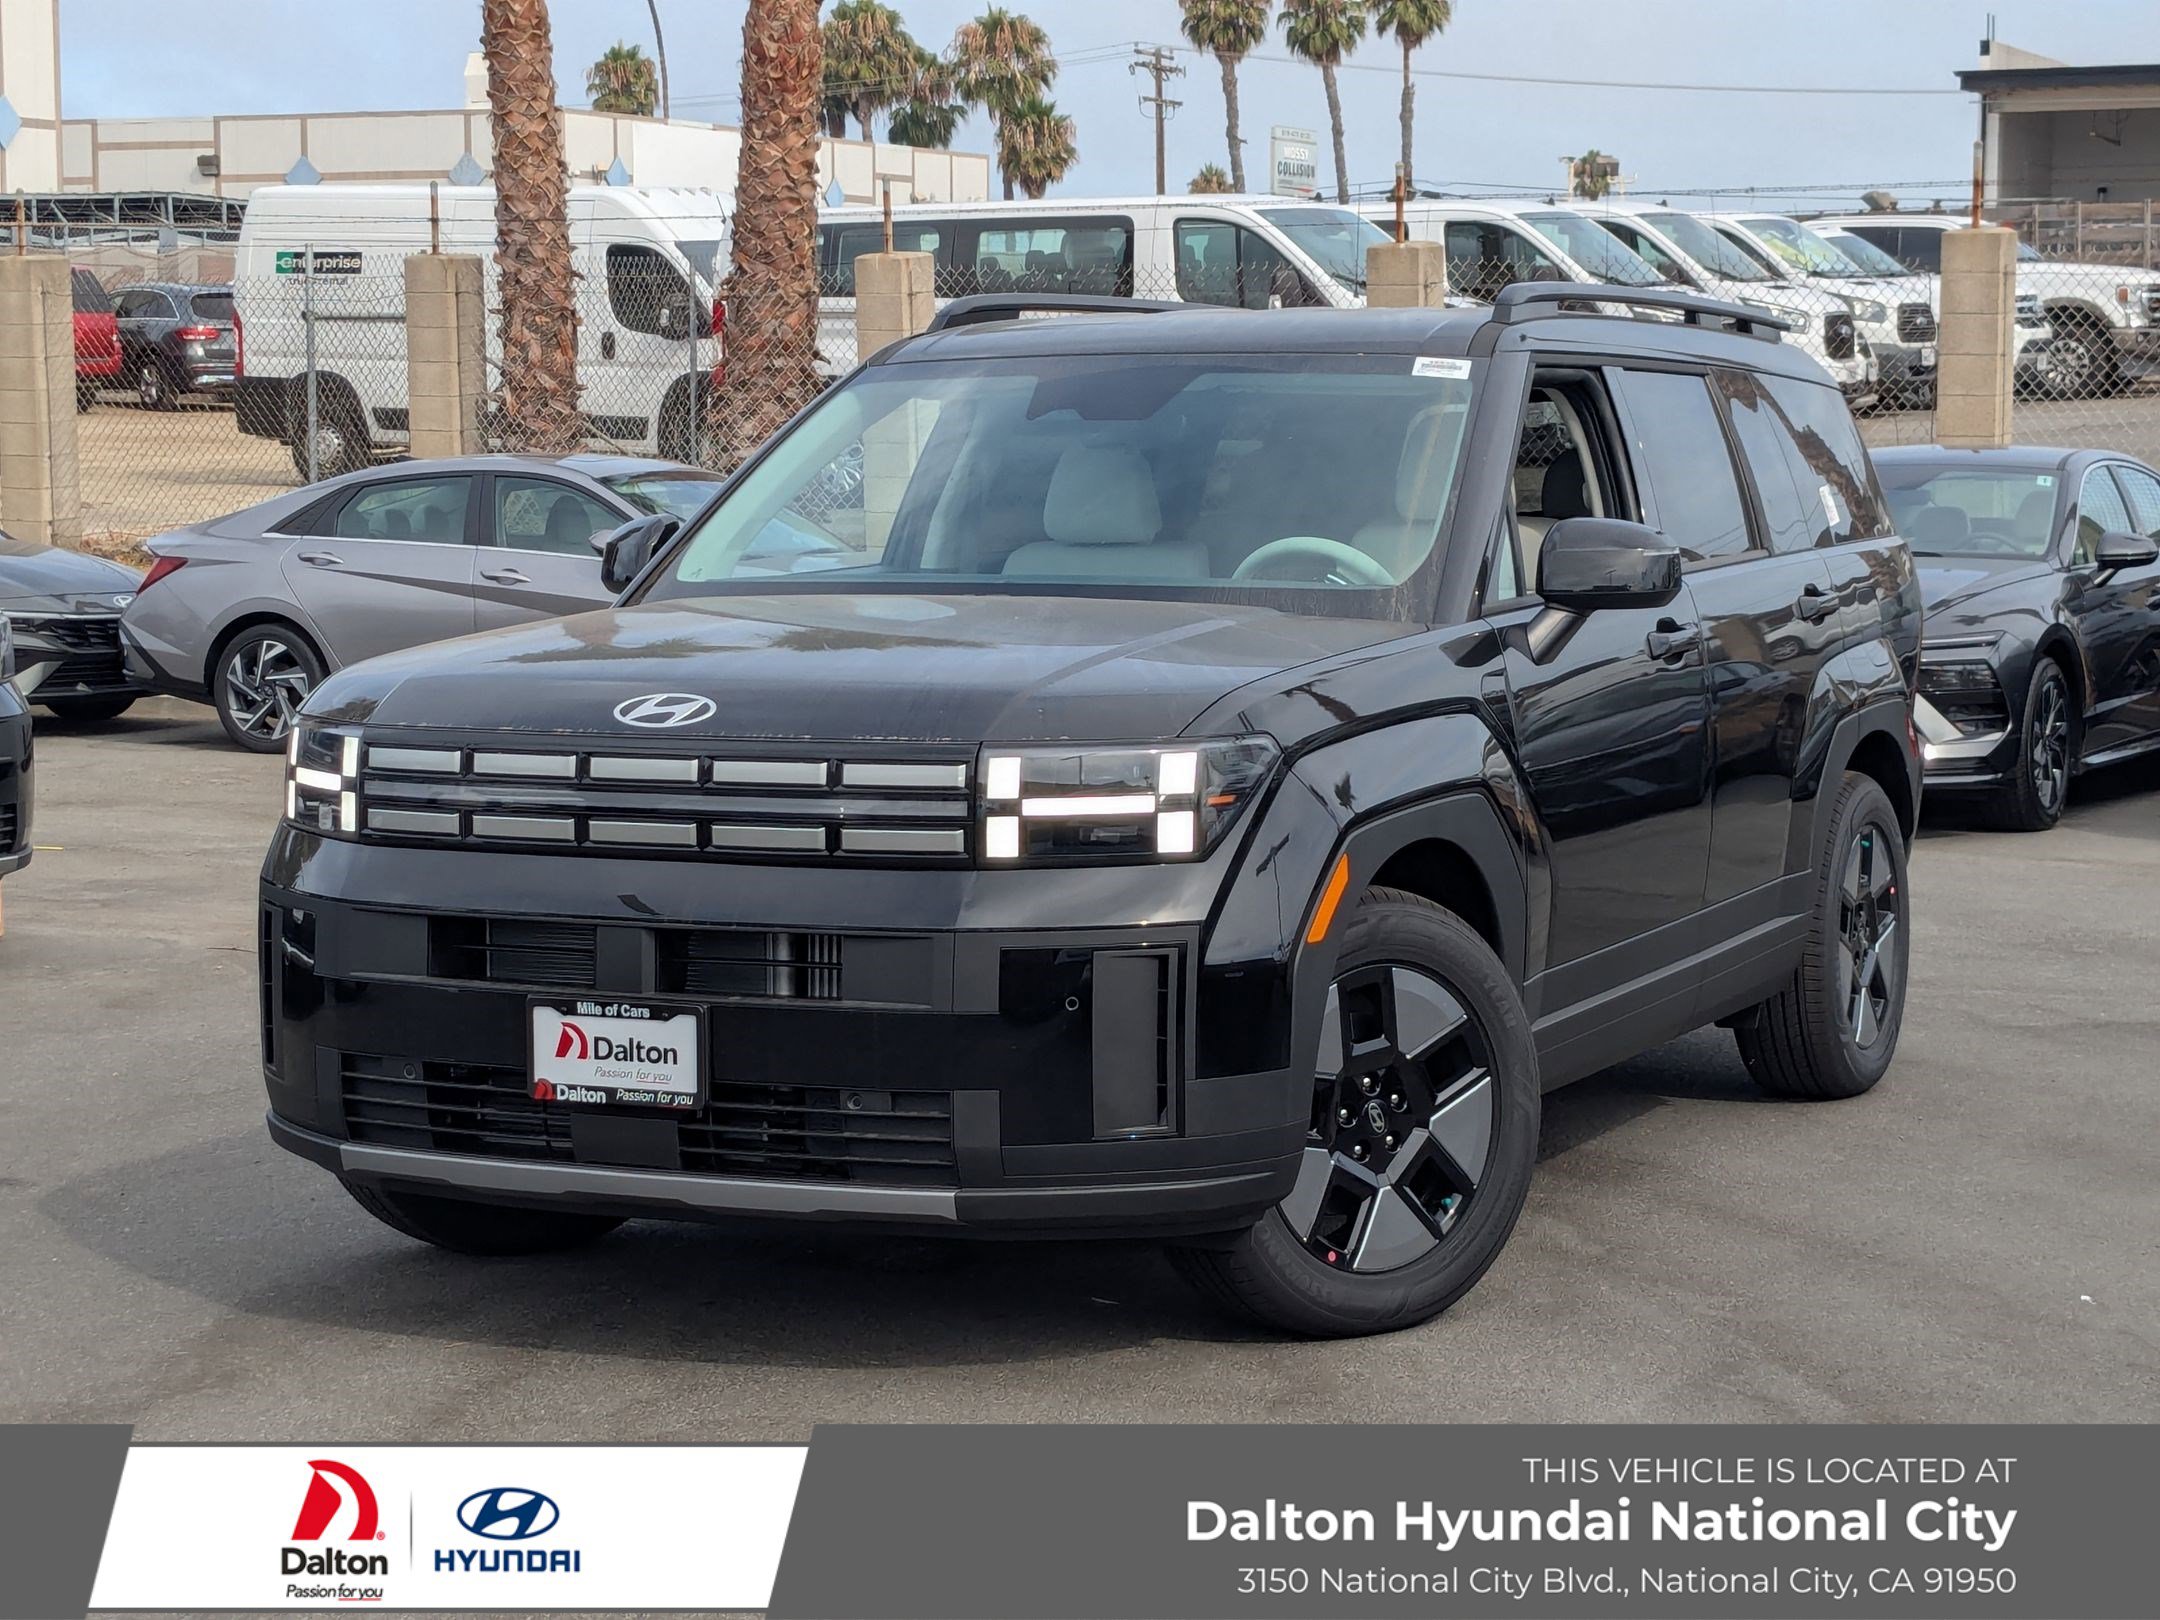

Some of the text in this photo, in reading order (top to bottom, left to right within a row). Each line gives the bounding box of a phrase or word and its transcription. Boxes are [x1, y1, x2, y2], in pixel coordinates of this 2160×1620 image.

[1277, 160, 1315, 178] COLLISION
[279, 254, 361, 271] entrprise
[576, 1001, 651, 1018] Mile of Cars
[593, 1036, 678, 1066] Dalton
[594, 1065, 673, 1083] Passion for you
[556, 1084, 694, 1106] Dalton Passion for you
